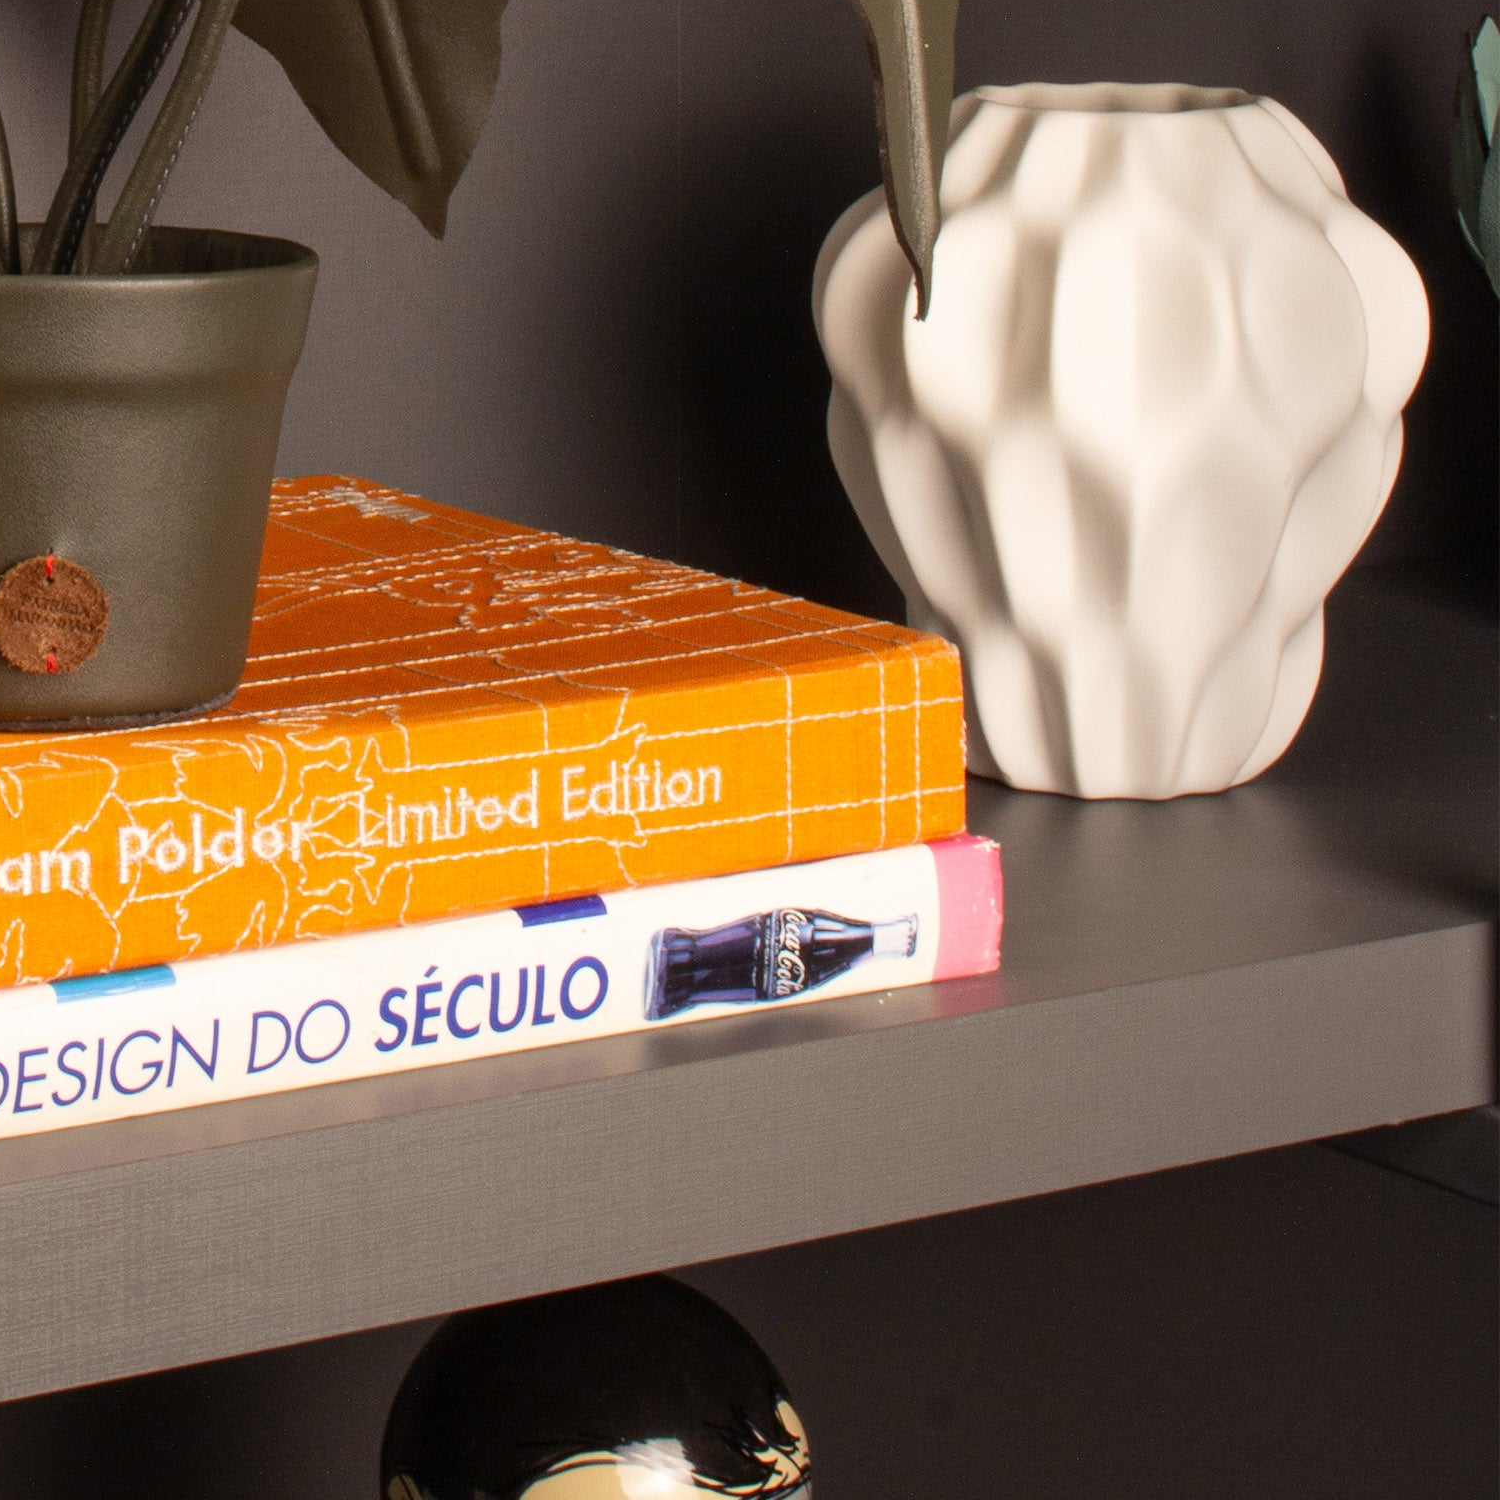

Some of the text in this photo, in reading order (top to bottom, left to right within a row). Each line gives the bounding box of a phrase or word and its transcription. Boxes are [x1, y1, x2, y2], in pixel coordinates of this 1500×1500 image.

[118, 806, 314, 884] Polder
[357, 768, 540, 849] Limited
[561, 759, 723, 821] Edition
[246, 999, 351, 1074] DO
[374, 955, 609, 1052] SÉCULO
